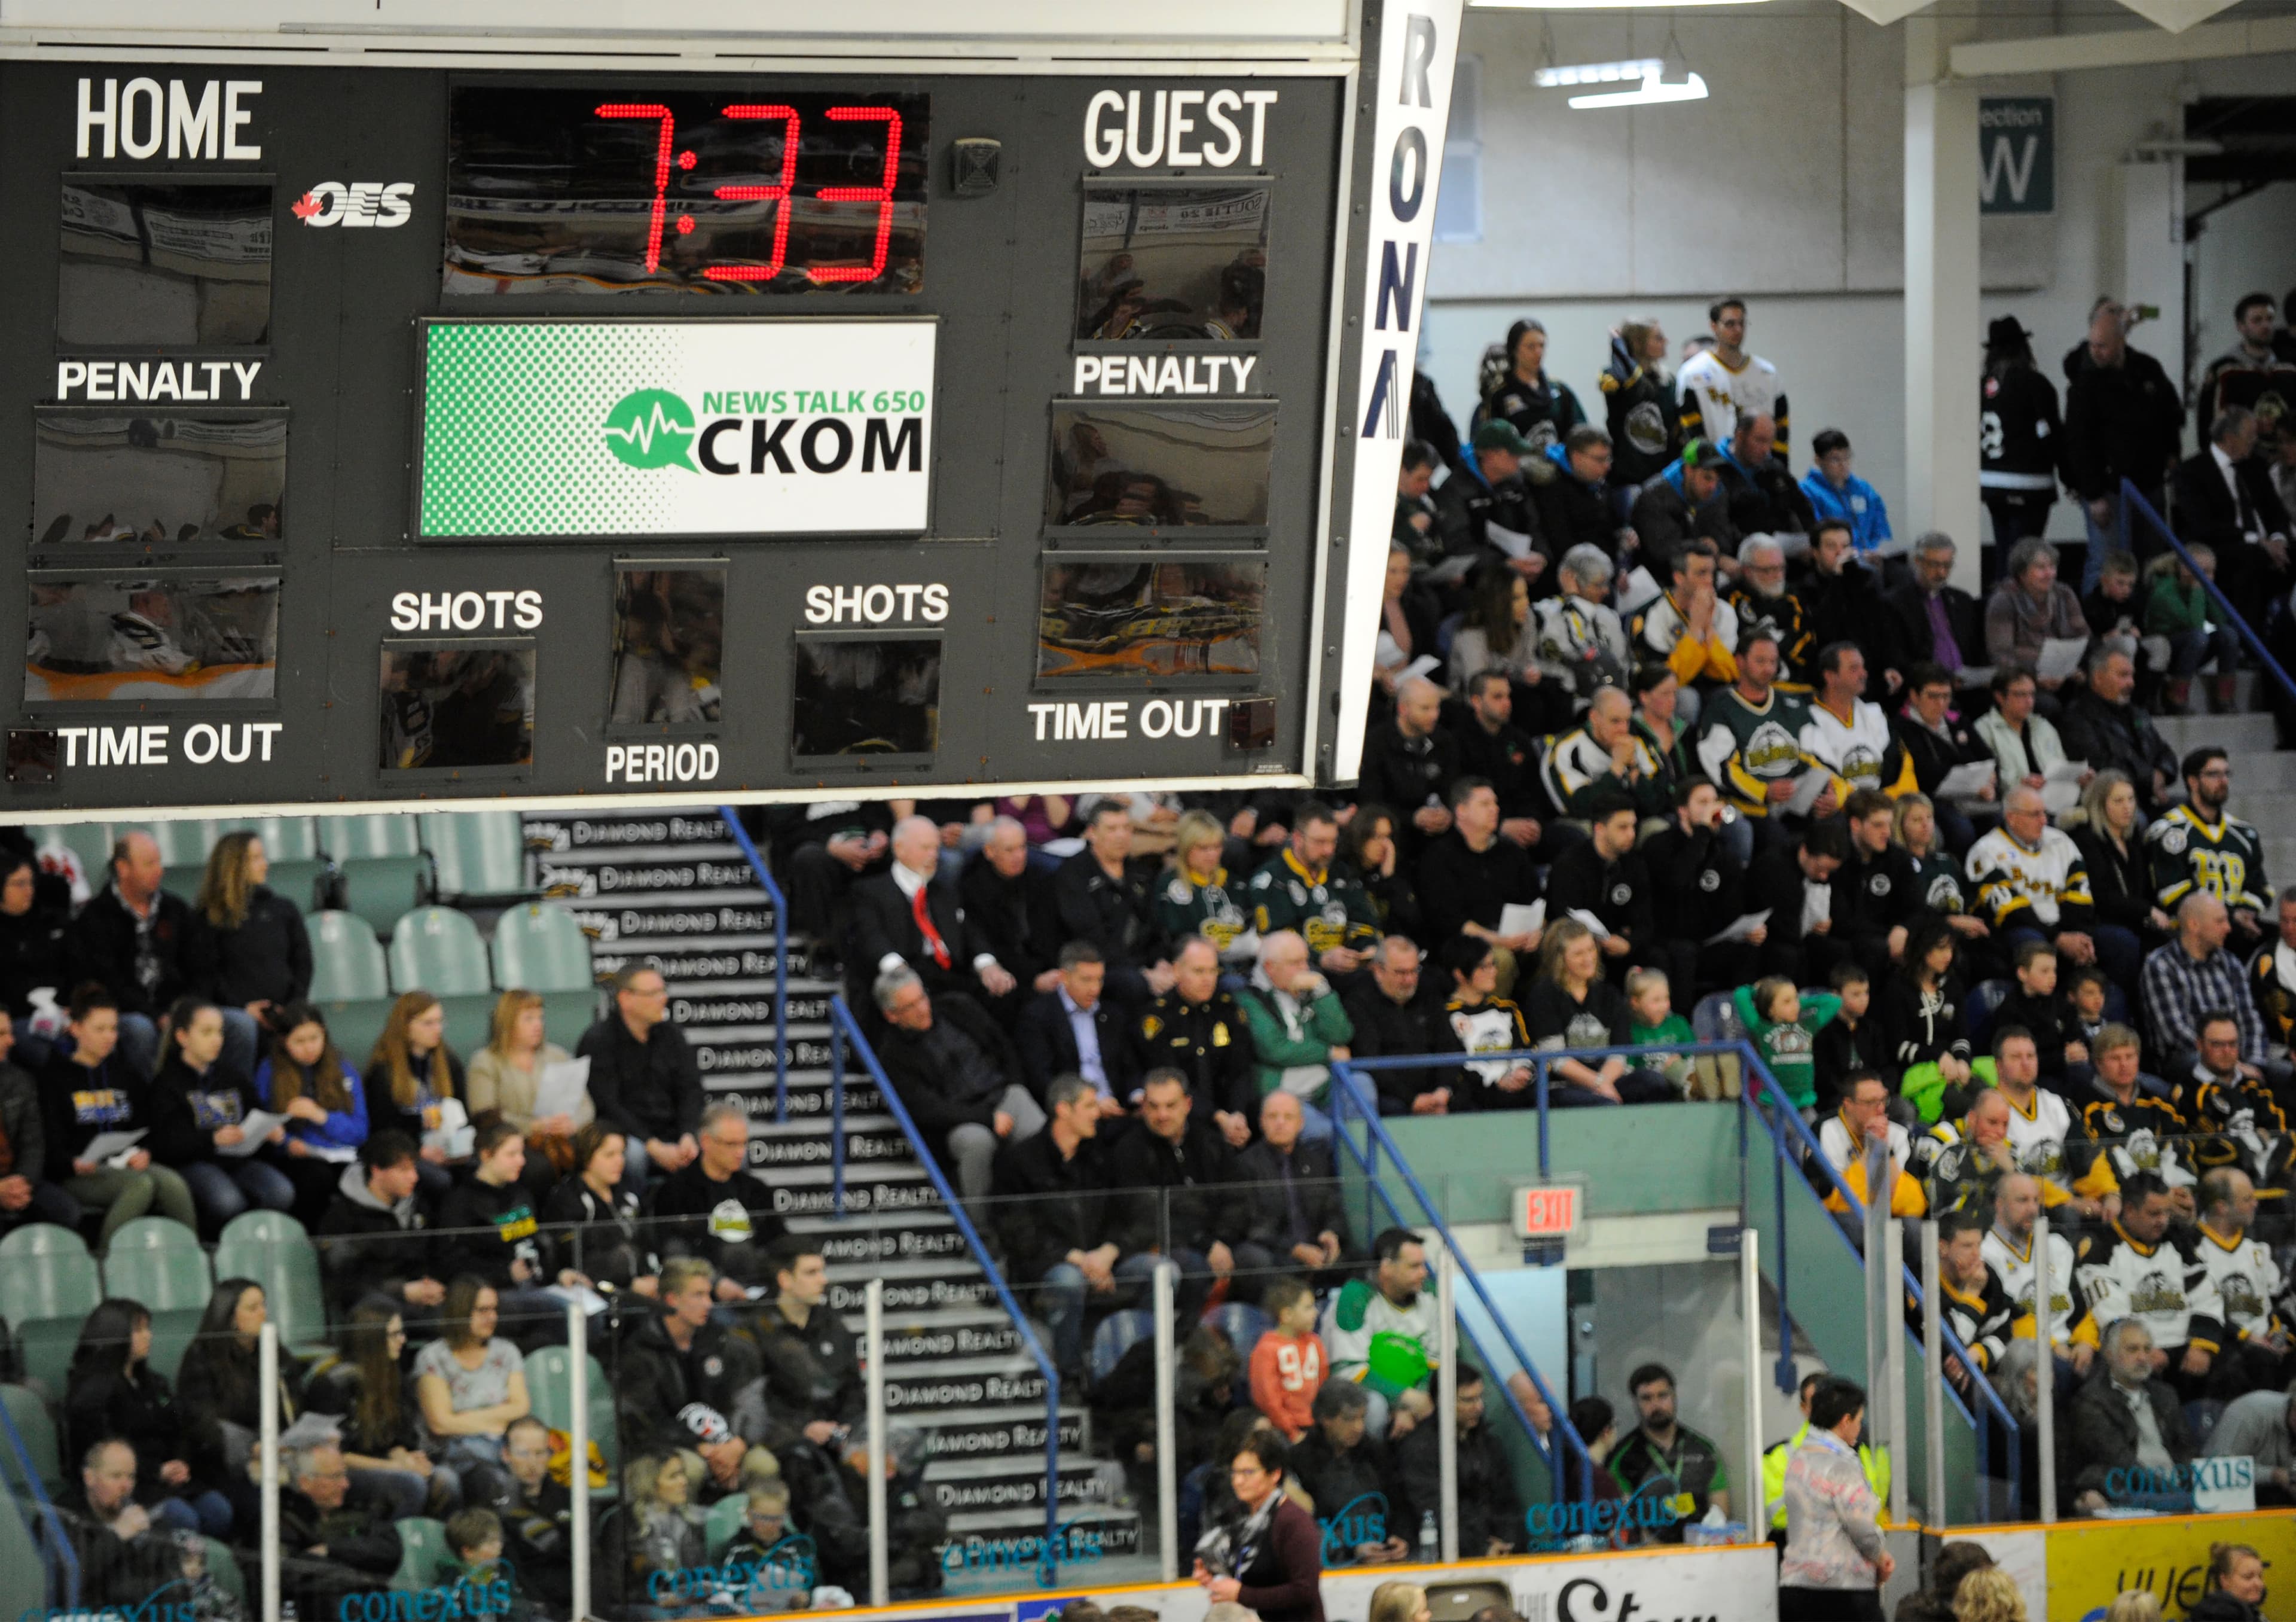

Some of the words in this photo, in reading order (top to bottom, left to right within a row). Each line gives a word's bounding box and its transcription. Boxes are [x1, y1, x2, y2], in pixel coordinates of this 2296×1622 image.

[77, 77, 262, 160] HOME
[1084, 89, 1278, 168] GUEST
[1980, 104, 2042, 127] ection
[1980, 134, 2038, 203] W
[304, 181, 416, 228] OES
[594, 104, 902, 282] 7:33
[1360, 13, 1437, 440] RONA
[57, 362, 262, 401] PENALTY
[1074, 356, 1257, 395] PENALTY
[702, 391, 787, 414] NEWS
[793, 391, 866, 413] TALK
[872, 390, 926, 412] 650
[698, 417, 923, 475] CKOM
[390, 590, 543, 631] SHOTS
[805, 583, 949, 623] SHOTS
[1027, 703, 1128, 741] TIME
[1140, 699, 1230, 738] OUT
[57, 726, 169, 767] TIME
[183, 723, 282, 763] OUT
[606, 743, 719, 783] PERIOD
[572, 821, 668, 844] DIAMOND
[599, 866, 695, 890] DIAMOND
[697, 862, 755, 885] REALT
[621, 910, 718, 934] DIAMOND
[719, 907, 774, 931] REALT
[741, 951, 807, 974] REATY
[672, 999, 770, 1023] DIAMOND
[784, 999, 832, 1019] EALT
[824, 1087, 882, 1111] REALT
[749, 1140, 832, 1164] DIAMON
[1527, 1189, 1575, 1233] EXIT
[821, 1236, 897, 1257] AMOND
[830, 1286, 930, 1310] DIAOND
[856, 1334, 955, 1361] DAMOND
[1277, 1341, 1320, 1392] 94
[927, 1431, 1010, 1453] IAMOND
[1013, 1425, 1081, 1447] REATY
[936, 1483, 1036, 1508] DIAMOND
[2105, 1456, 2253, 1508] conexus
[1525, 1484, 1678, 1543] conexus
[966, 1534, 1063, 1559] DIAMO
[338, 1568, 513, 1621] conexus
[647, 1548, 814, 1610] conexus
